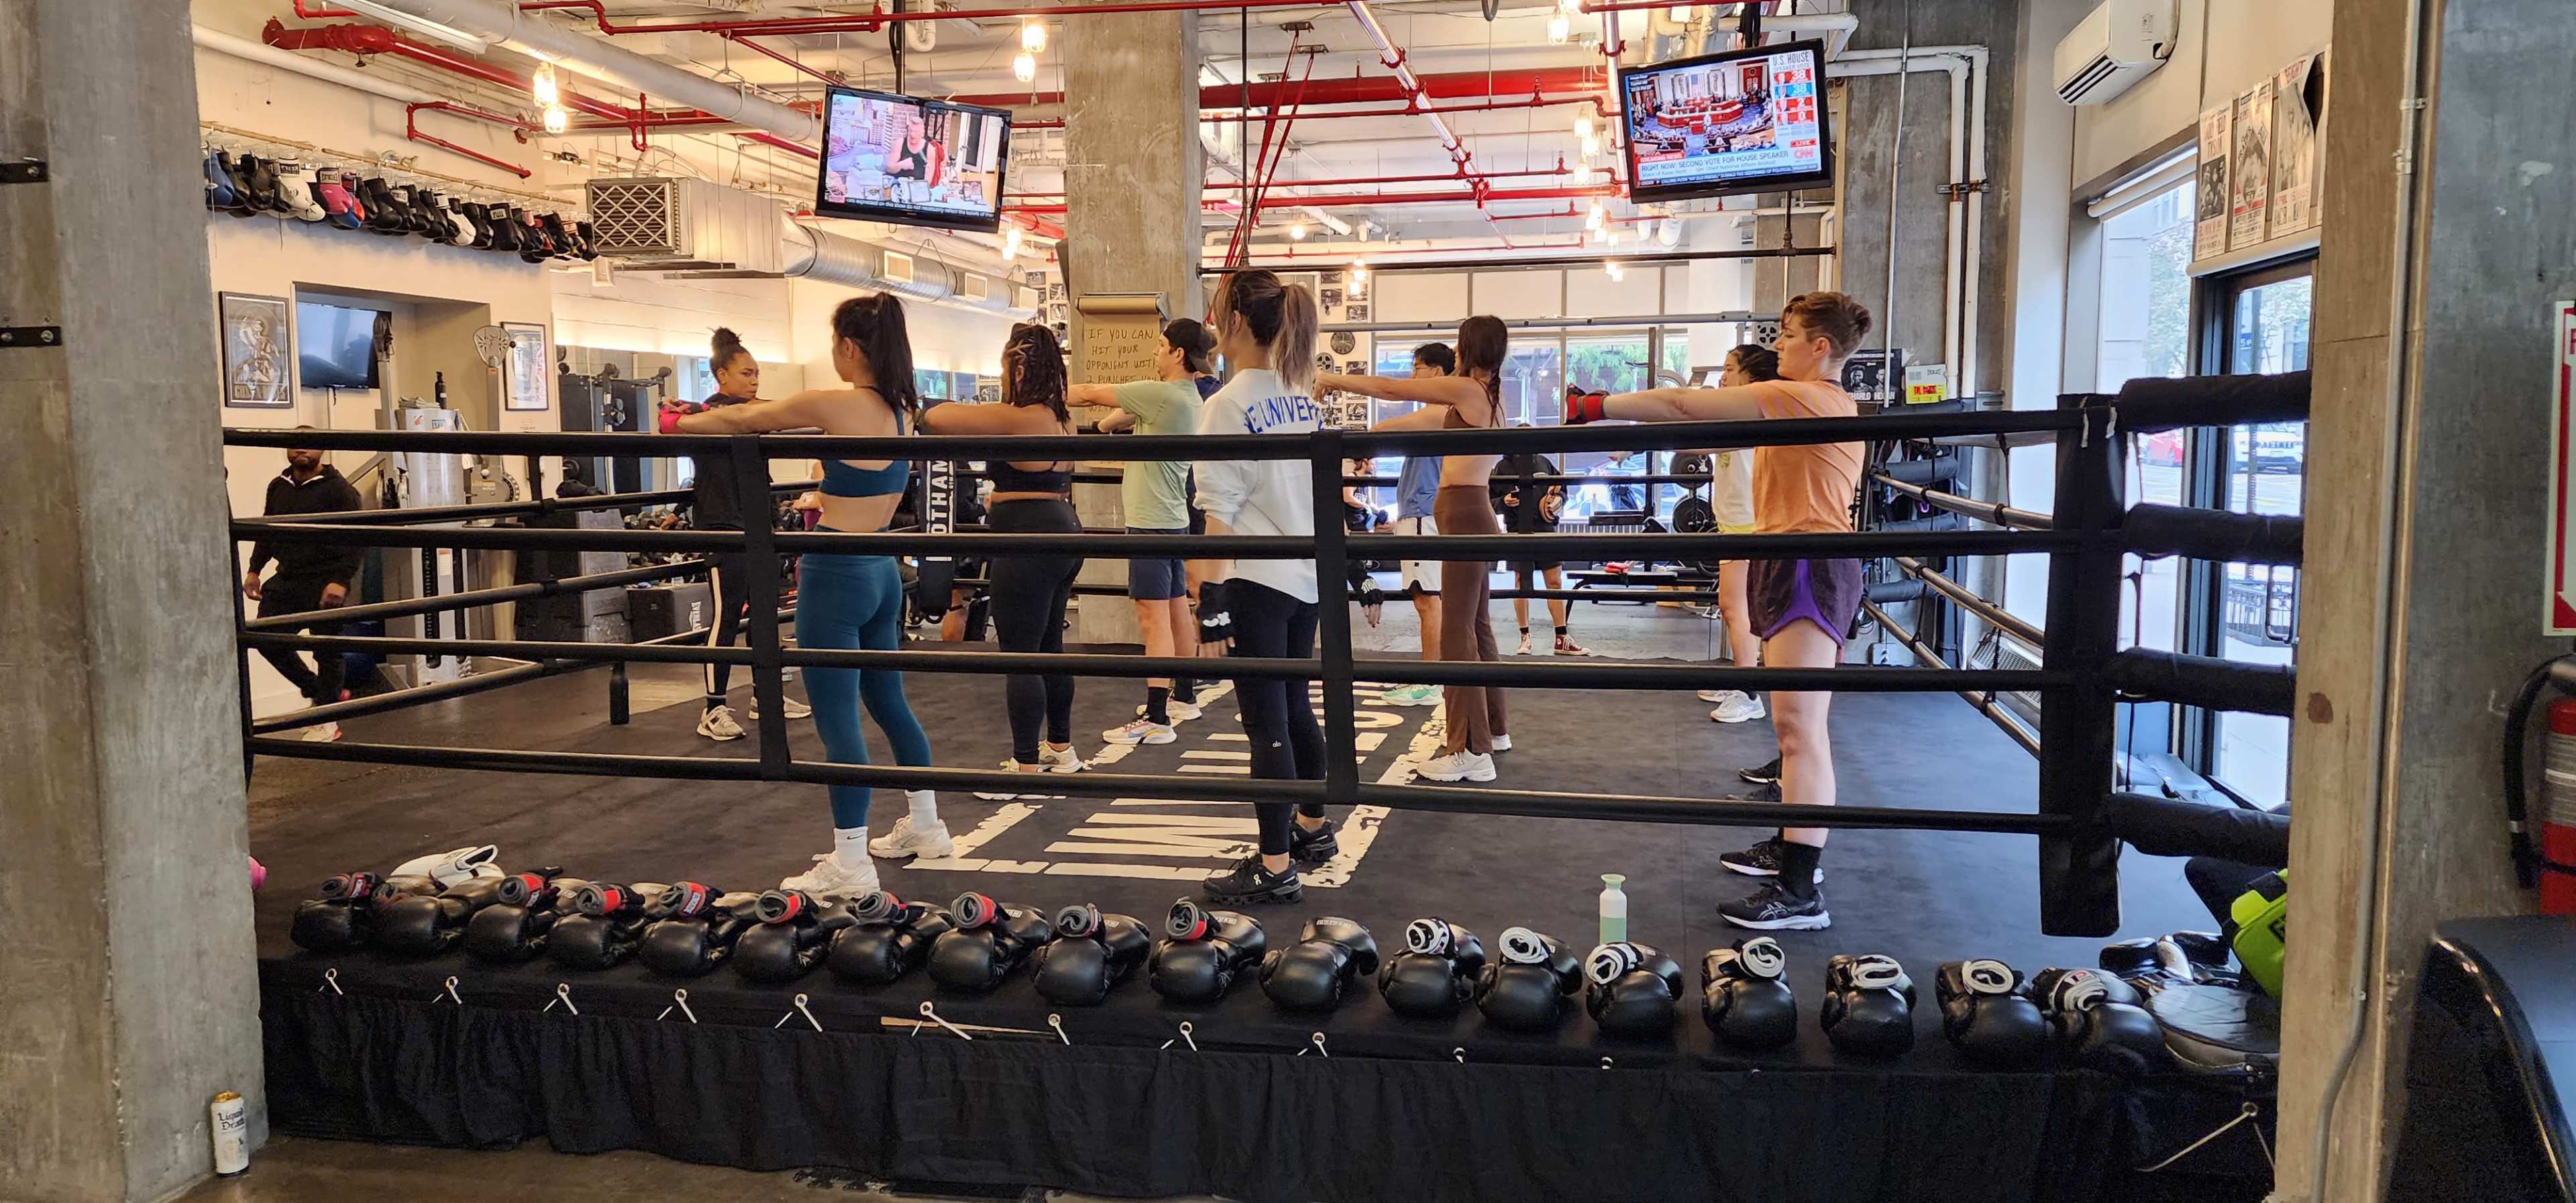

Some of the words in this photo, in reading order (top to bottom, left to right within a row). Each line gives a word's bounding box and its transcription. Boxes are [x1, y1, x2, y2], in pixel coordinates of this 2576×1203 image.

[1773, 55, 1785, 66] U.S.
[1788, 52, 1809, 64] HOUSE
[1793, 70, 1806, 81] 38
[1794, 84, 1807, 93] 38
[1794, 149, 1814, 159] CNN
[1642, 164, 1659, 172] RIGHT
[1678, 160, 1703, 168] SECOND
[1705, 158, 1721, 166] VOTE
[1736, 154, 1759, 162] HOUSE
[1760, 151, 1788, 160] SPEAKER
[1087, 328, 1104, 339] IF
[1110, 328, 1128, 342] YOU
[1131, 328, 1154, 339] CAN
[1091, 345, 1111, 356] HIT
[1118, 344, 1138, 359] YOUR
[1086, 359, 1128, 370] OPPONENT
[1085, 374, 1094, 384] 2
[1257, 395, 1322, 429] UNIVER
[930, 460, 949, 534] OTHAM
